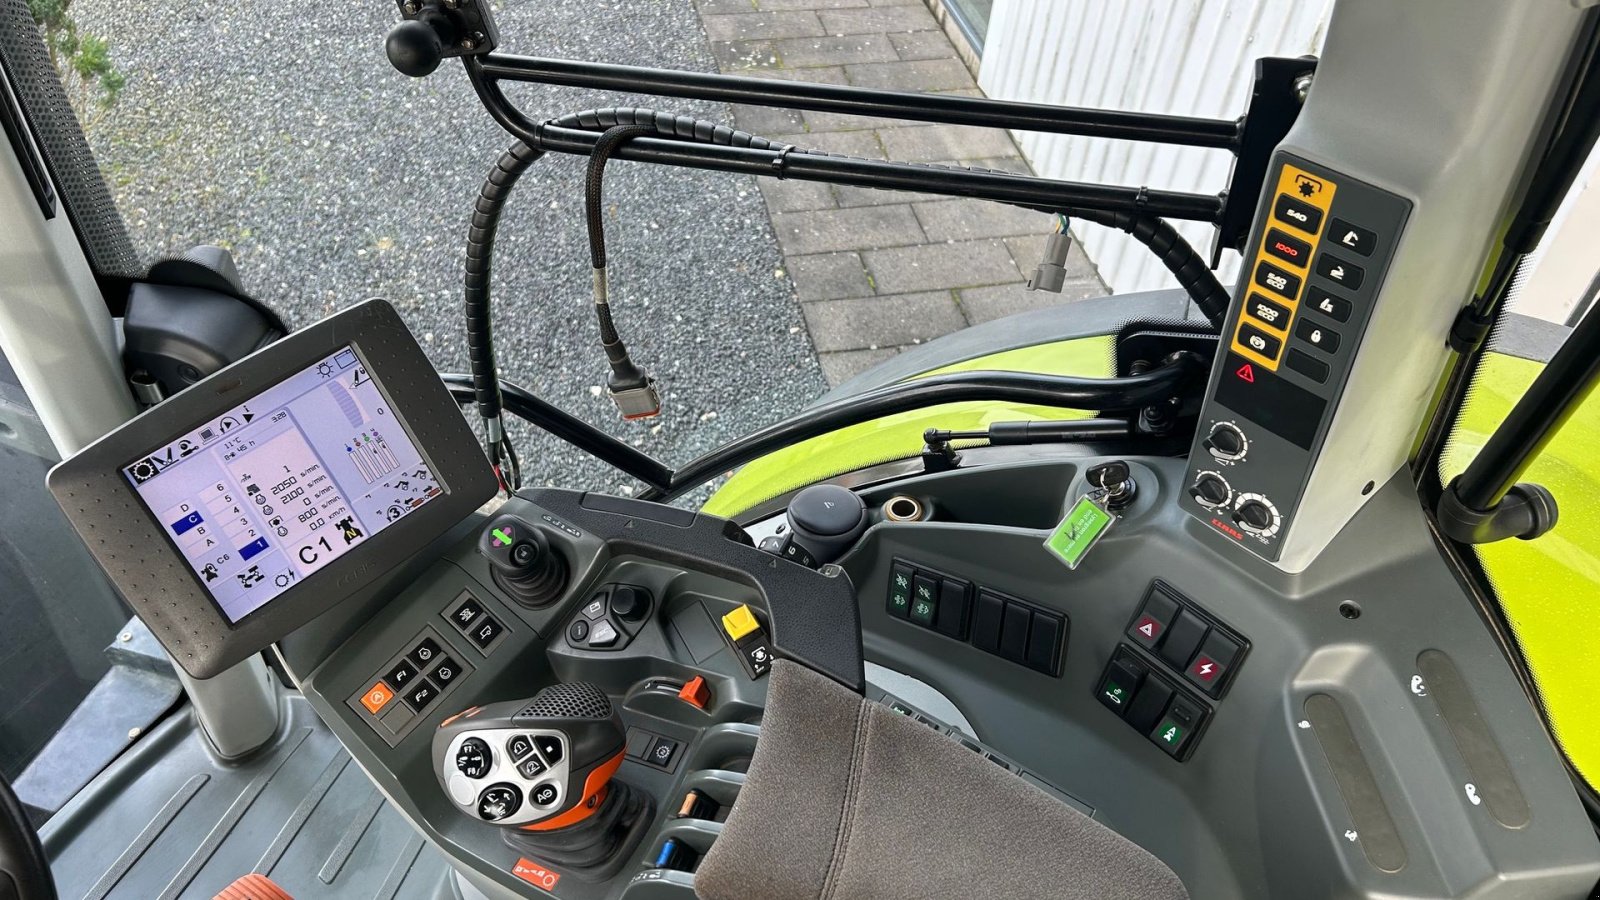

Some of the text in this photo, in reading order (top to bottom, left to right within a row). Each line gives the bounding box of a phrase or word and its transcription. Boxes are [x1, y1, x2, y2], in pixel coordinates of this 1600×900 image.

[1286, 208, 1307, 222] 540
[1275, 242, 1298, 256] 1000
[1267, 272, 1287, 285] 540
[1266, 279, 1284, 290] ECO
[1256, 303, 1278, 317] 1000
[1256, 310, 1274, 321] ECO
[270, 476, 298, 496] 2050
[280, 486, 304, 504] 2100
[302, 497, 312, 506] 0
[180, 504, 189, 512] D
[188, 515, 198, 523] C
[298, 508, 318, 522] 800
[197, 526, 206, 534] B
[346, 530, 357, 539] N
[206, 538, 214, 546] A
[216, 554, 230, 564] C6
[396, 670, 407, 682] F1
[416, 690, 428, 702] F2
